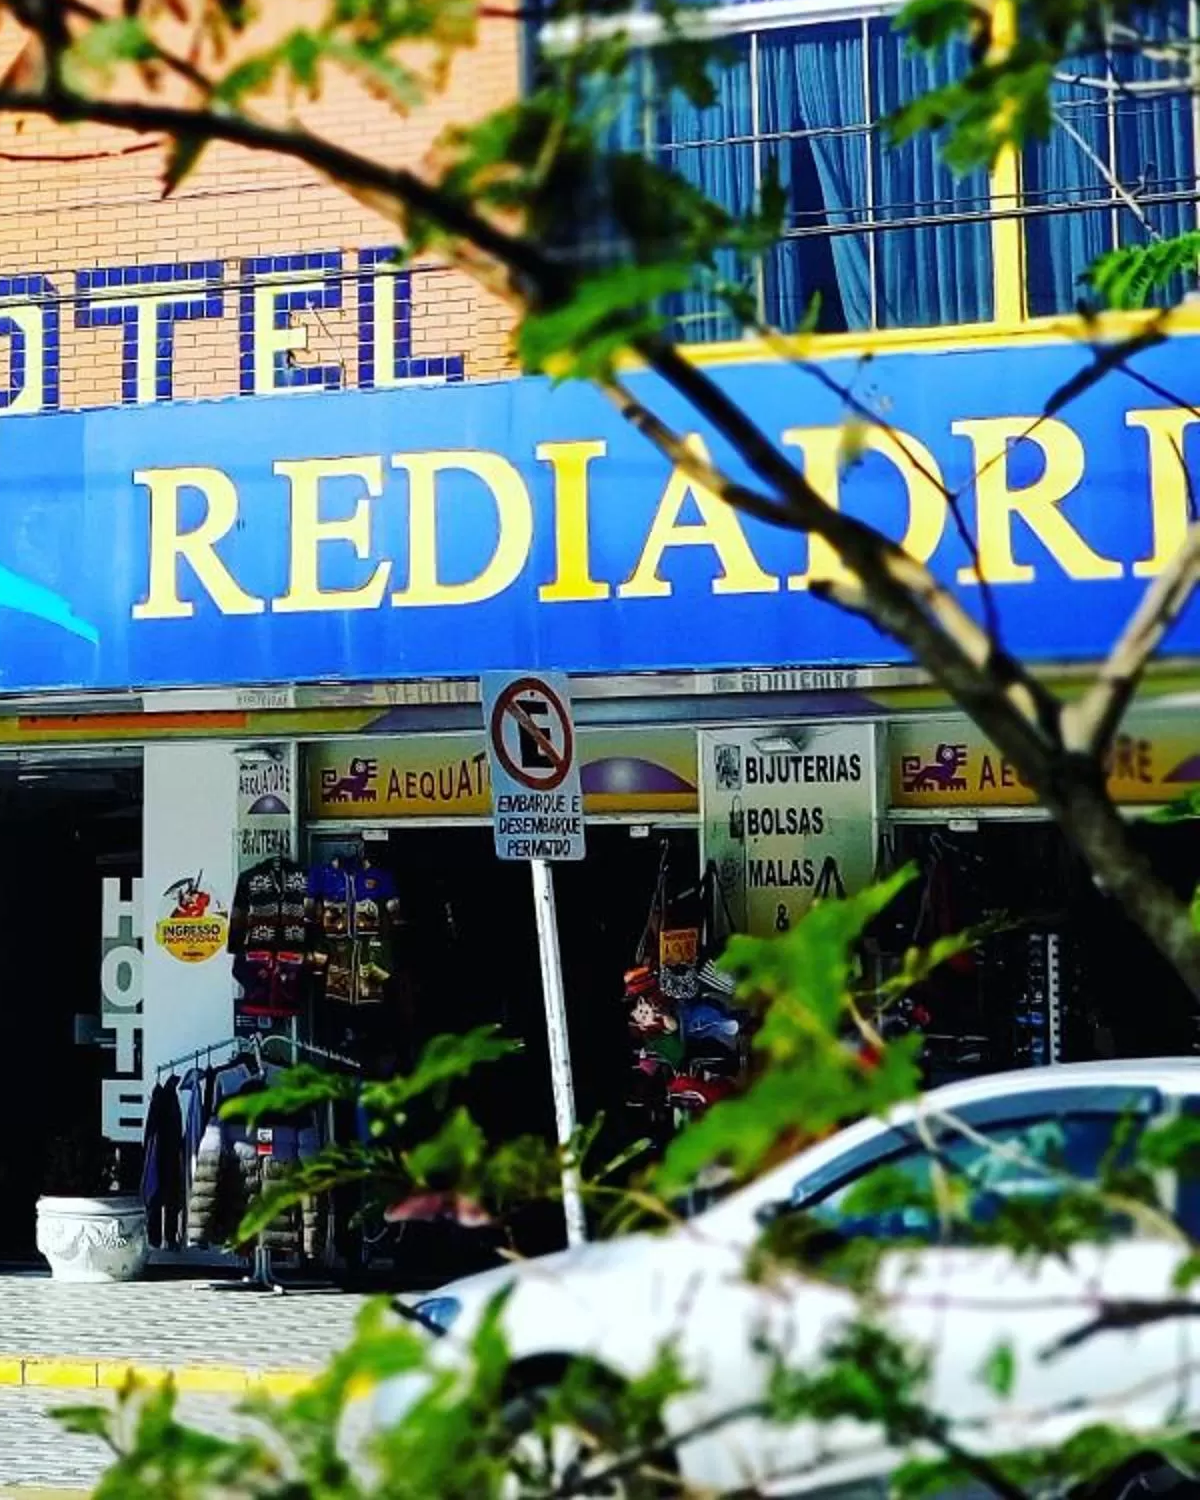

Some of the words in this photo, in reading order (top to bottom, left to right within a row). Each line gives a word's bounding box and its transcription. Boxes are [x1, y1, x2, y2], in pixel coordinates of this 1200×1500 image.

[131, 406, 1200, 620] REDIADRI
[387, 750, 487, 802] AEQUAT
[745, 754, 862, 784] BIJUTERIAS
[498, 795, 566, 814] EMBARQUE
[571, 796, 581, 813] E
[499, 817, 581, 835] DESEMBARQUE
[747, 807, 824, 835] BOLSAS
[749, 859, 814, 887] MALAS
[163, 923, 221, 937] INGRESSO
[775, 904, 790, 931] &
[101, 877, 144, 1190] HOTE
